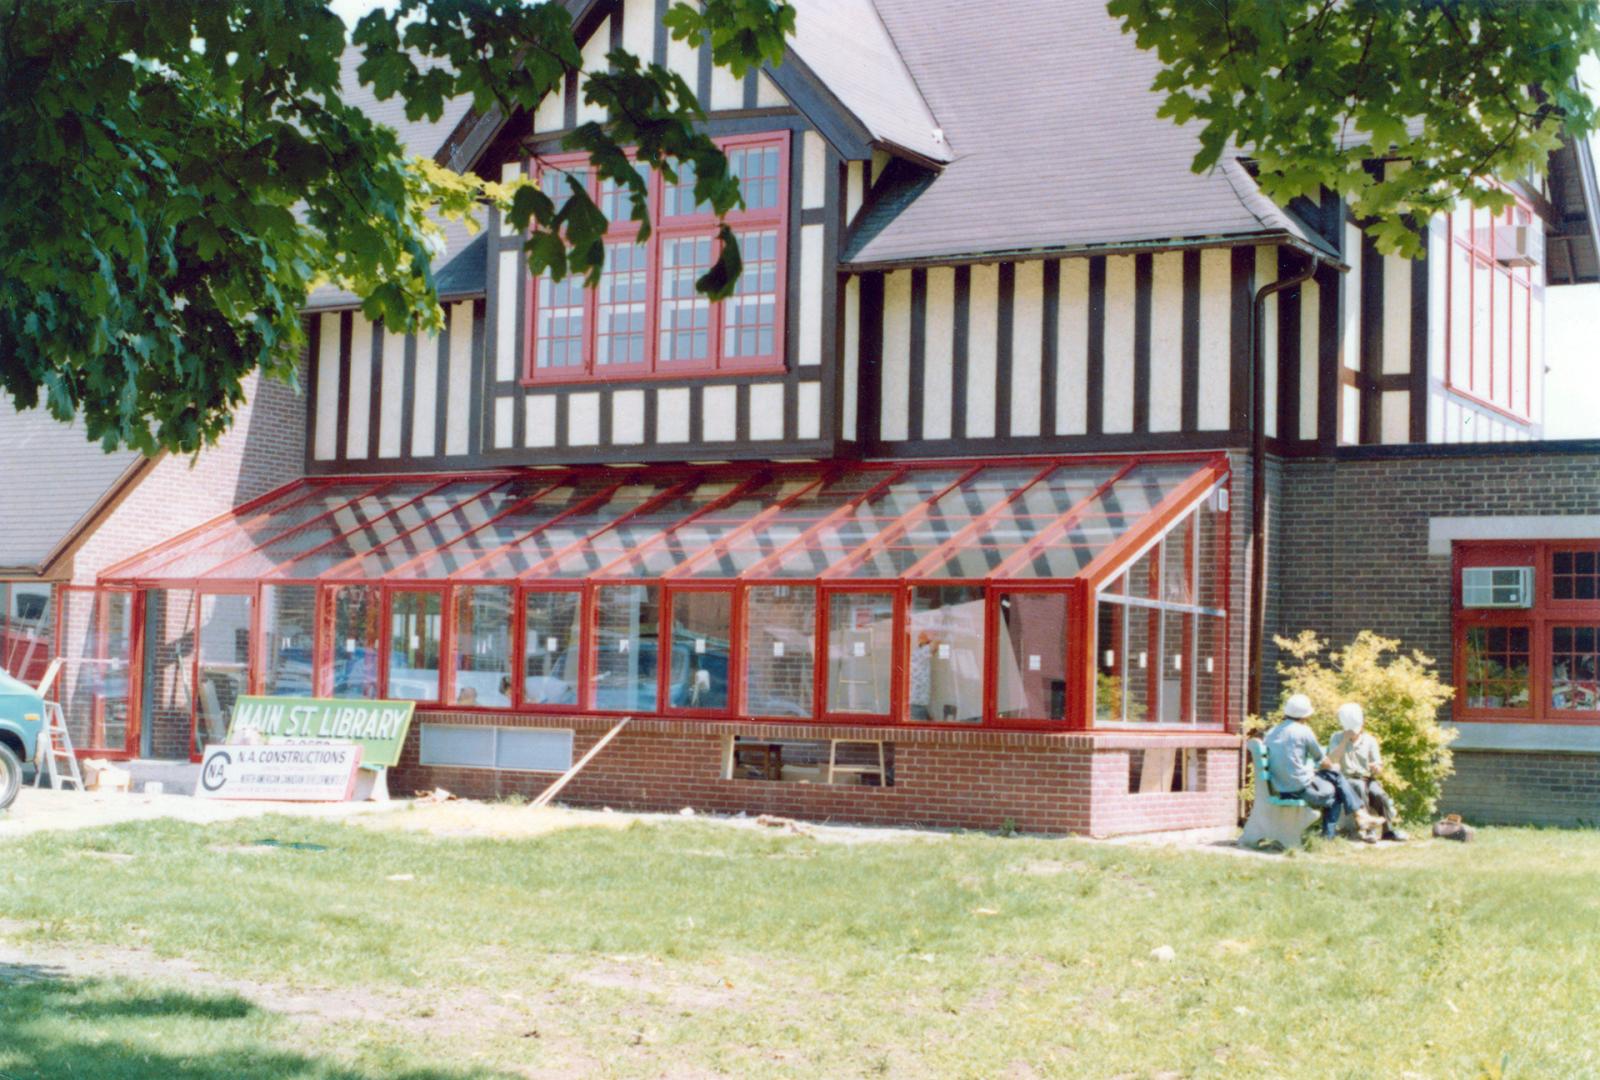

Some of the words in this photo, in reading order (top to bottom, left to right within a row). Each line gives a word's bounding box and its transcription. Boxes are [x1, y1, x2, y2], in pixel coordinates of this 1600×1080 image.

[233, 703, 284, 734] MAIN
[320, 708, 406, 739] LIBRARY
[259, 752, 346, 764] CONSTRUCTIONS
